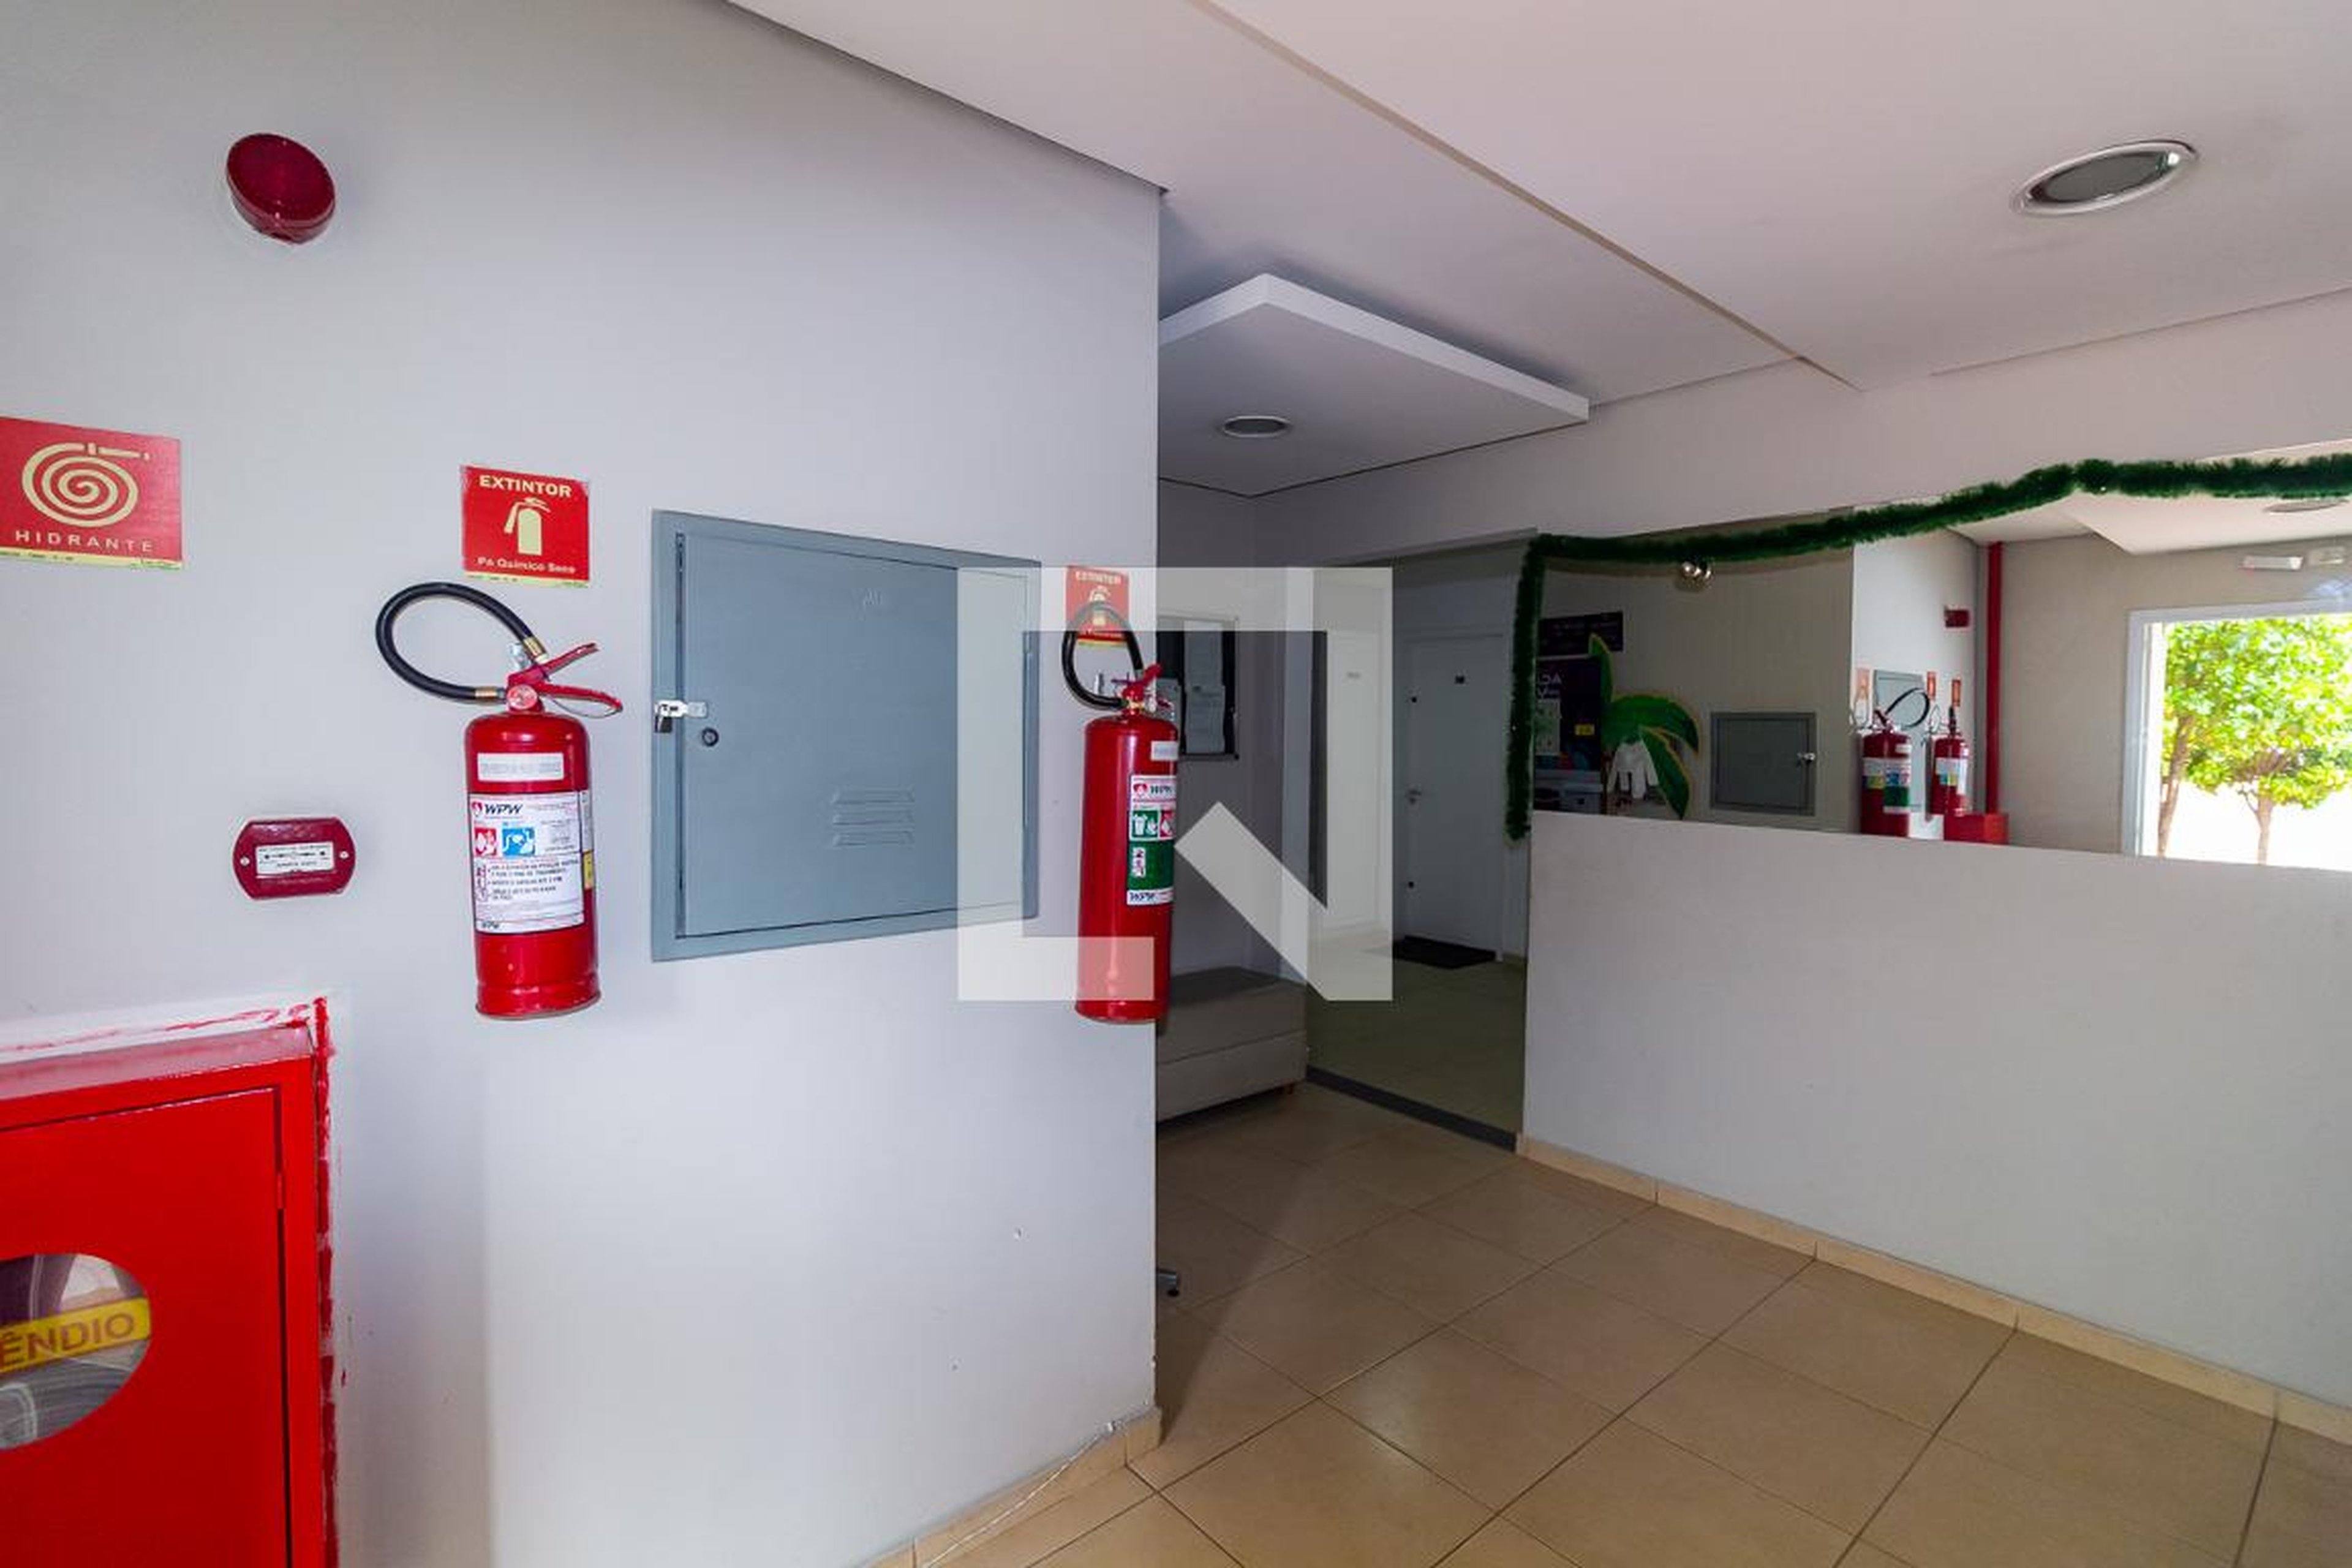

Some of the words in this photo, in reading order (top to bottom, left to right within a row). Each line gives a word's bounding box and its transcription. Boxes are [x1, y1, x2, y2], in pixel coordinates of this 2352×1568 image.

[479, 474, 572, 497] EXTINTOR
[15, 530, 154, 552] HIDRANTE
[484, 803, 523, 815] WPW
